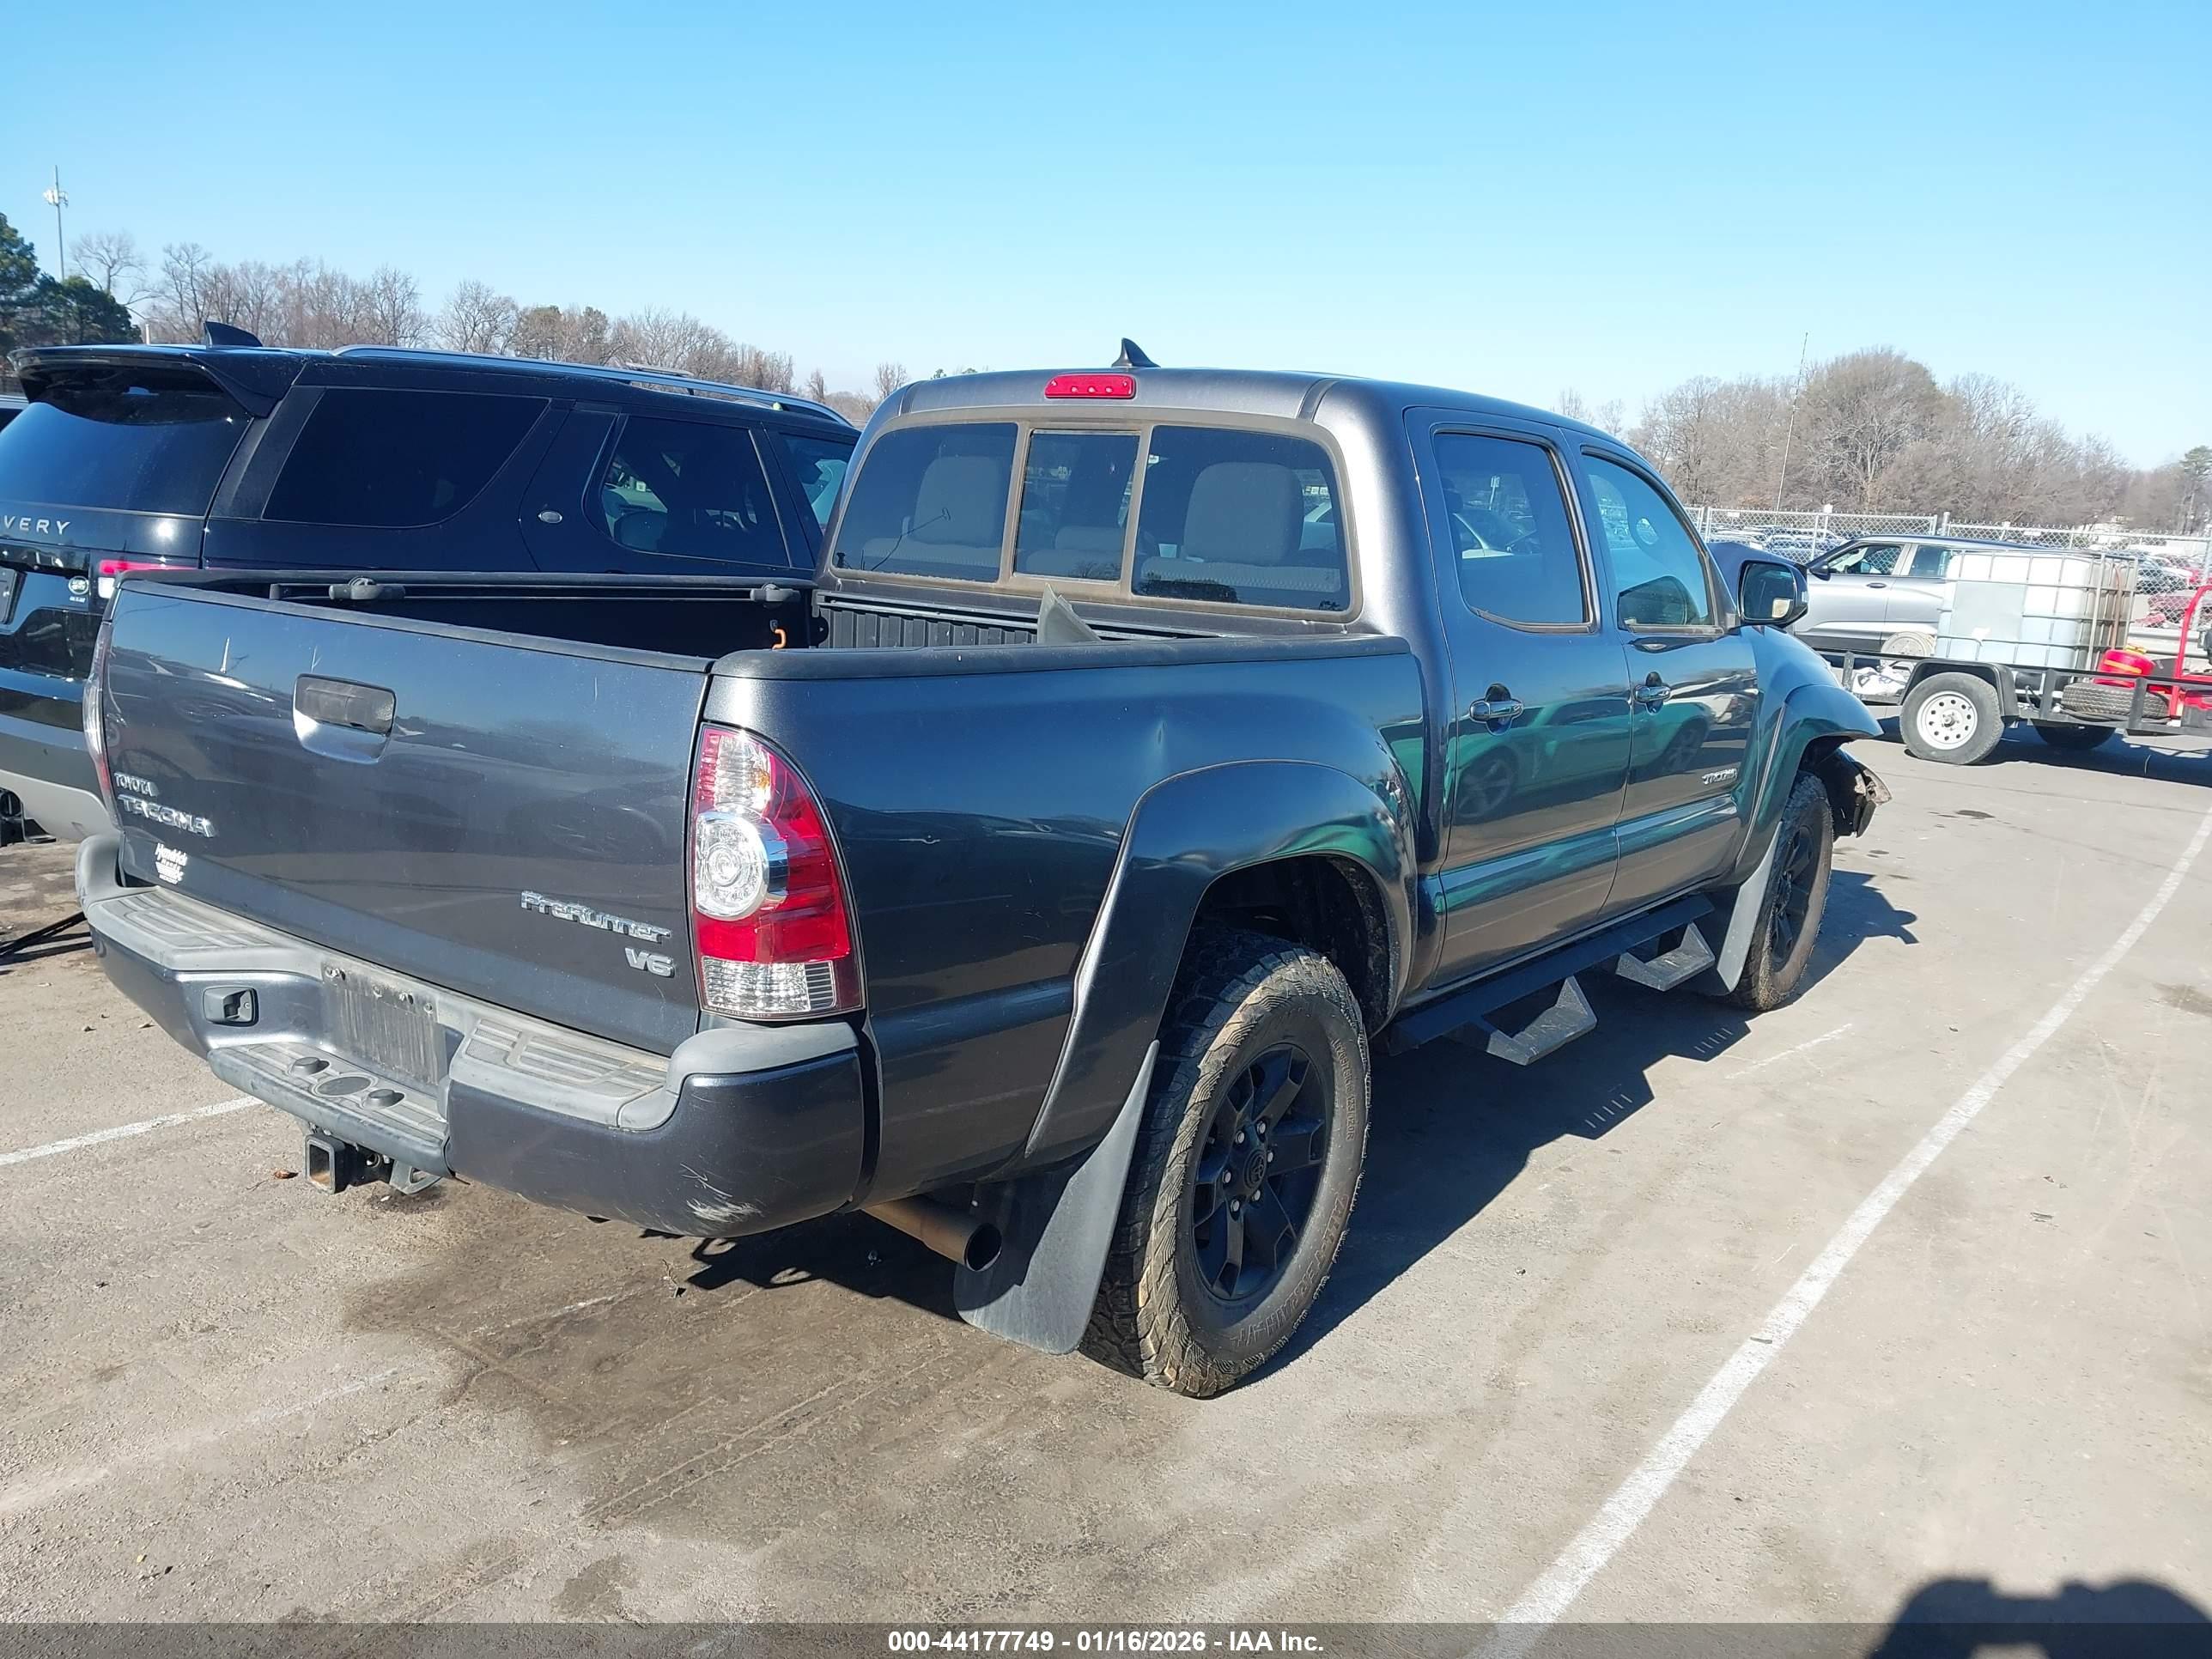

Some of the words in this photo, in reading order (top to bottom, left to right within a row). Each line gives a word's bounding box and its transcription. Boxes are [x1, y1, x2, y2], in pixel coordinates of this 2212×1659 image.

[114, 772, 160, 797] TOYOTA
[118, 793, 216, 838] TACOMA
[520, 890, 672, 944] PreRunner
[624, 946, 676, 978] V6
